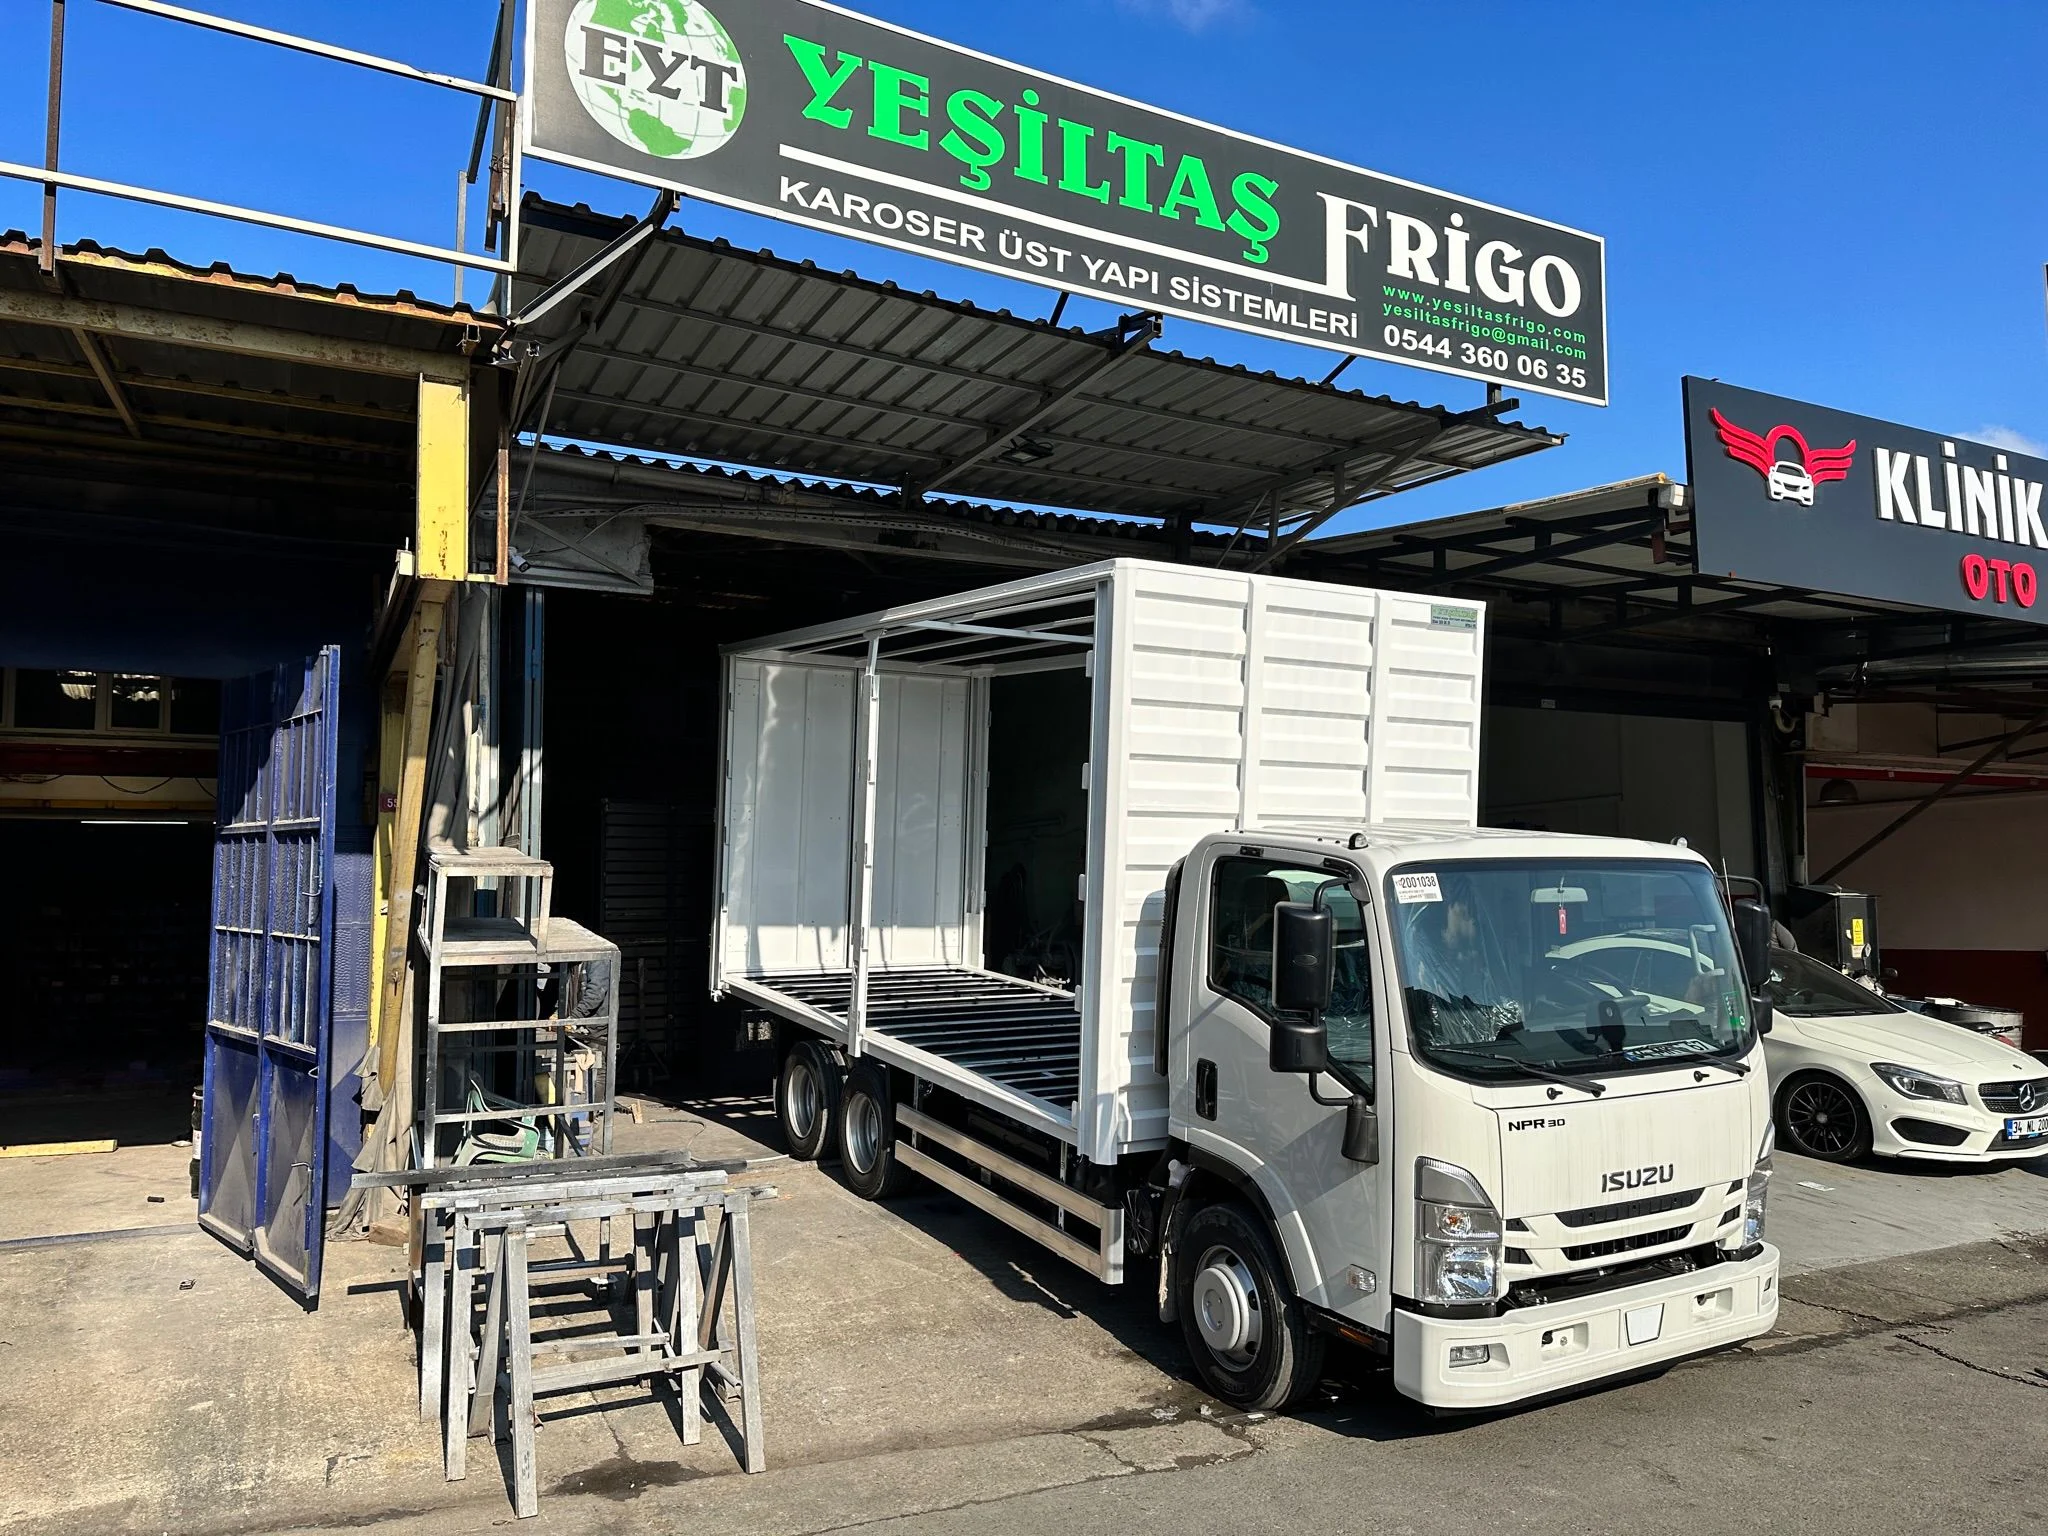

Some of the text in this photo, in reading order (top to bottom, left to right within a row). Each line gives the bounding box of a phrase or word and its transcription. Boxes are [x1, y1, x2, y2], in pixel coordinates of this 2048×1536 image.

[579, 24, 738, 114] EYT
[783, 34, 1281, 264] YEŞİLTAŞ
[779, 175, 1358, 339] KAROSER ÜST YAPI SİSTEMLERİ
[1316, 190, 1582, 318] FRİGO
[1382, 285, 1587, 344] www.yesiltasfrigo.com
[1382, 303, 1587, 360] yesiltasfrigo@gmail.com
[1383, 324, 1587, 389] 0544 360 06 35
[1873, 440, 2048, 550] KLİNİK
[1961, 553, 2037, 608] OTO
[1401, 876, 1436, 888] 2001038
[1508, 1118, 1566, 1132] NPR 30
[2013, 1121, 2022, 1133] 34
[2026, 1120, 2036, 1132] NL
[1601, 1163, 1674, 1193] ISUZU
